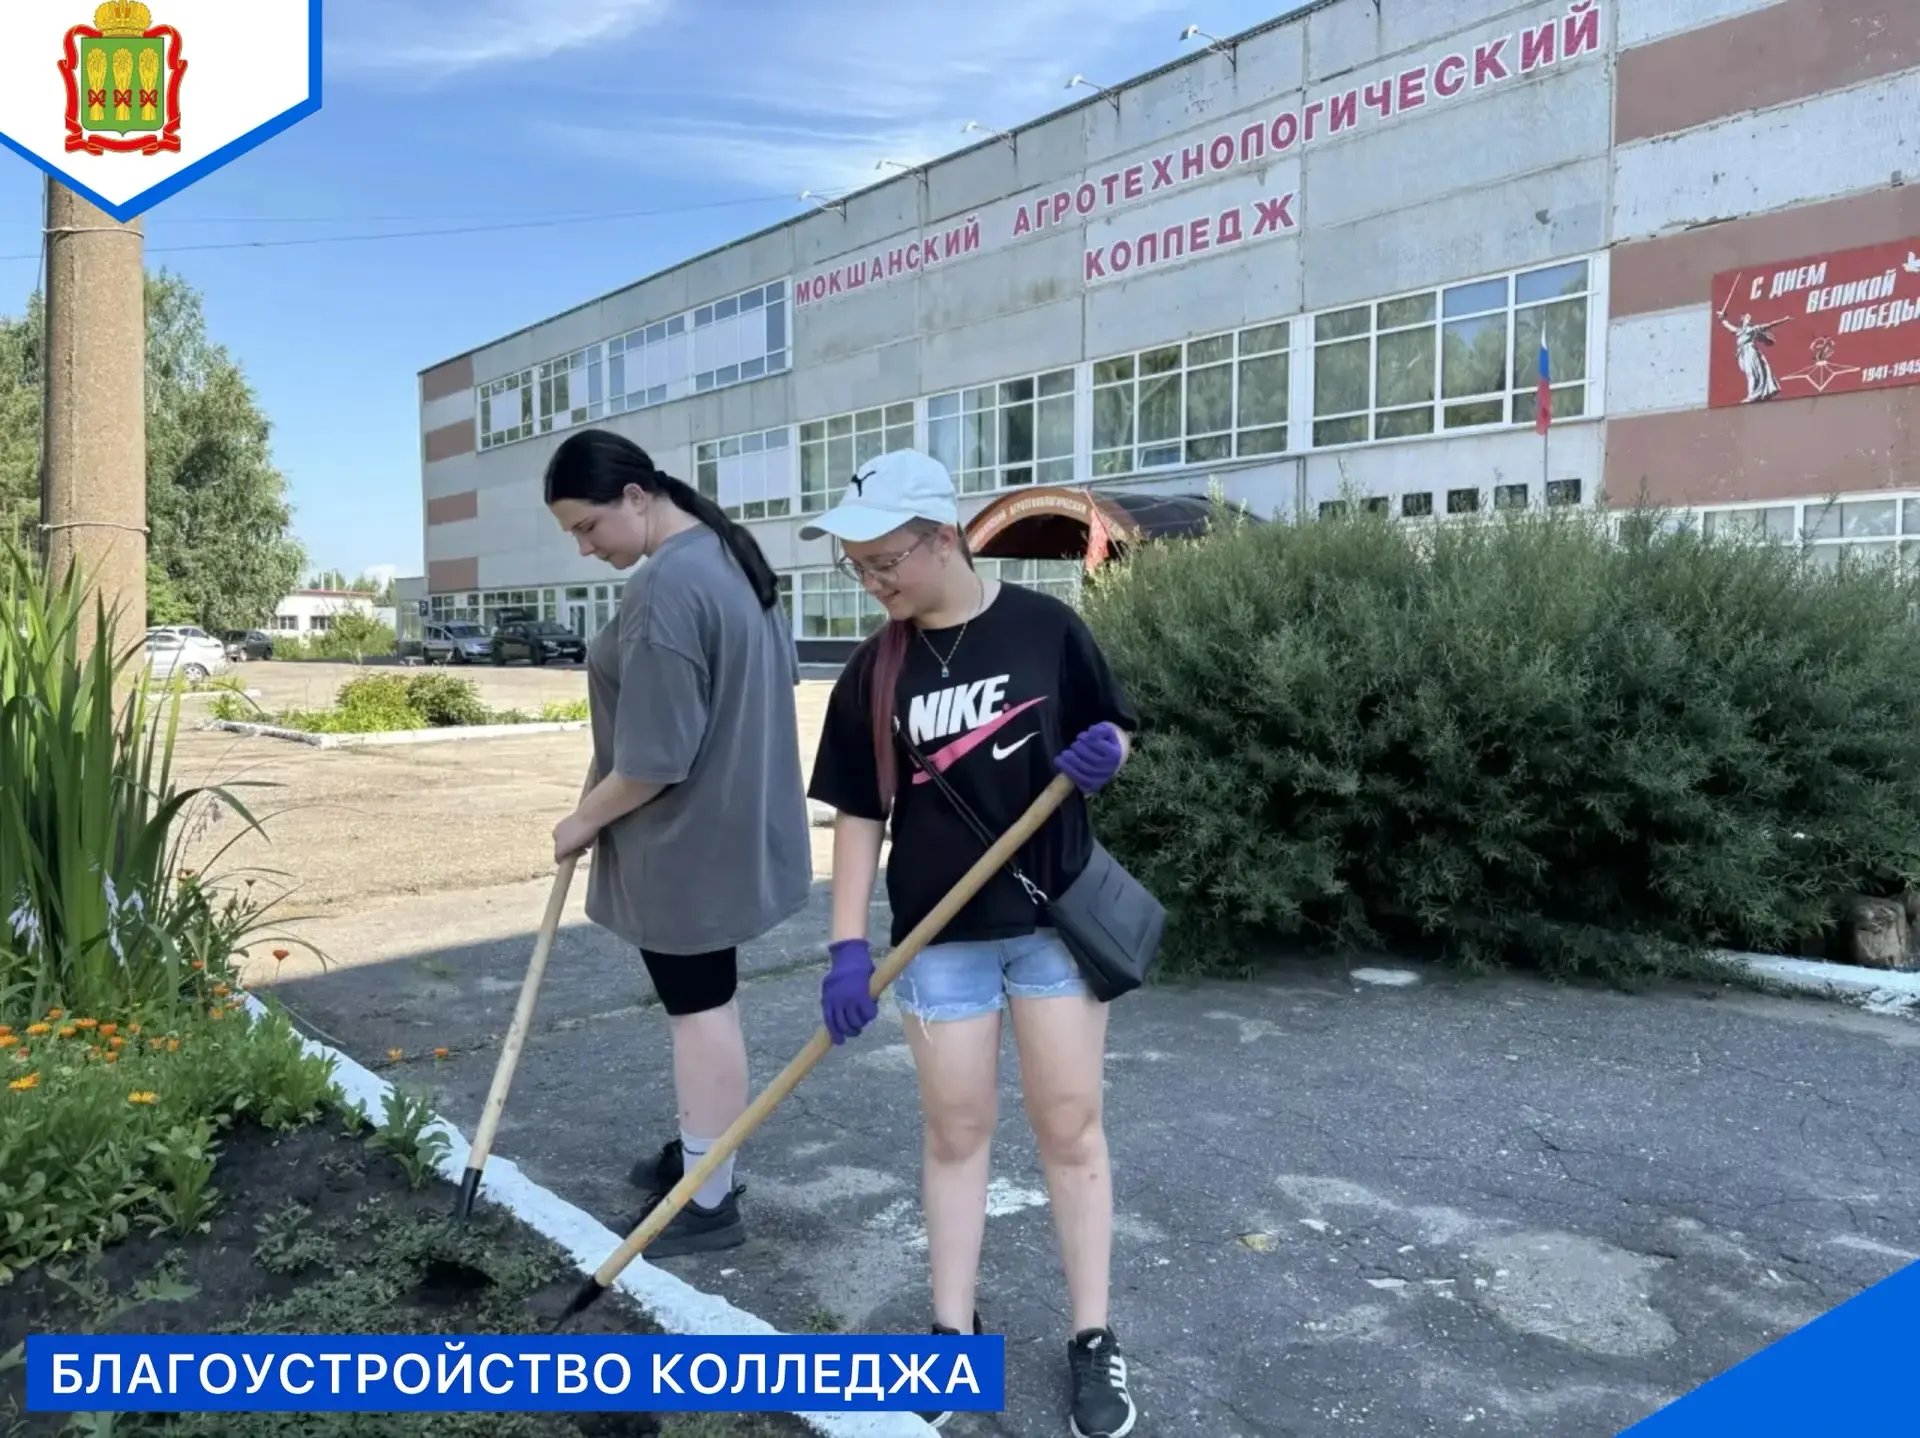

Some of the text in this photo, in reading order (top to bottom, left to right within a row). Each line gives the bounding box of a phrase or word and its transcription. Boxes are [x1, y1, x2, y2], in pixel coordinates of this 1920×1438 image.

[795, 215, 980, 306] МОКШАНСКИЙ
[1749, 261, 1828, 300] С ДНЕМ
[1805, 268, 1897, 314] ВЕЛИКОЙ
[908, 673, 1011, 747] NIKE
